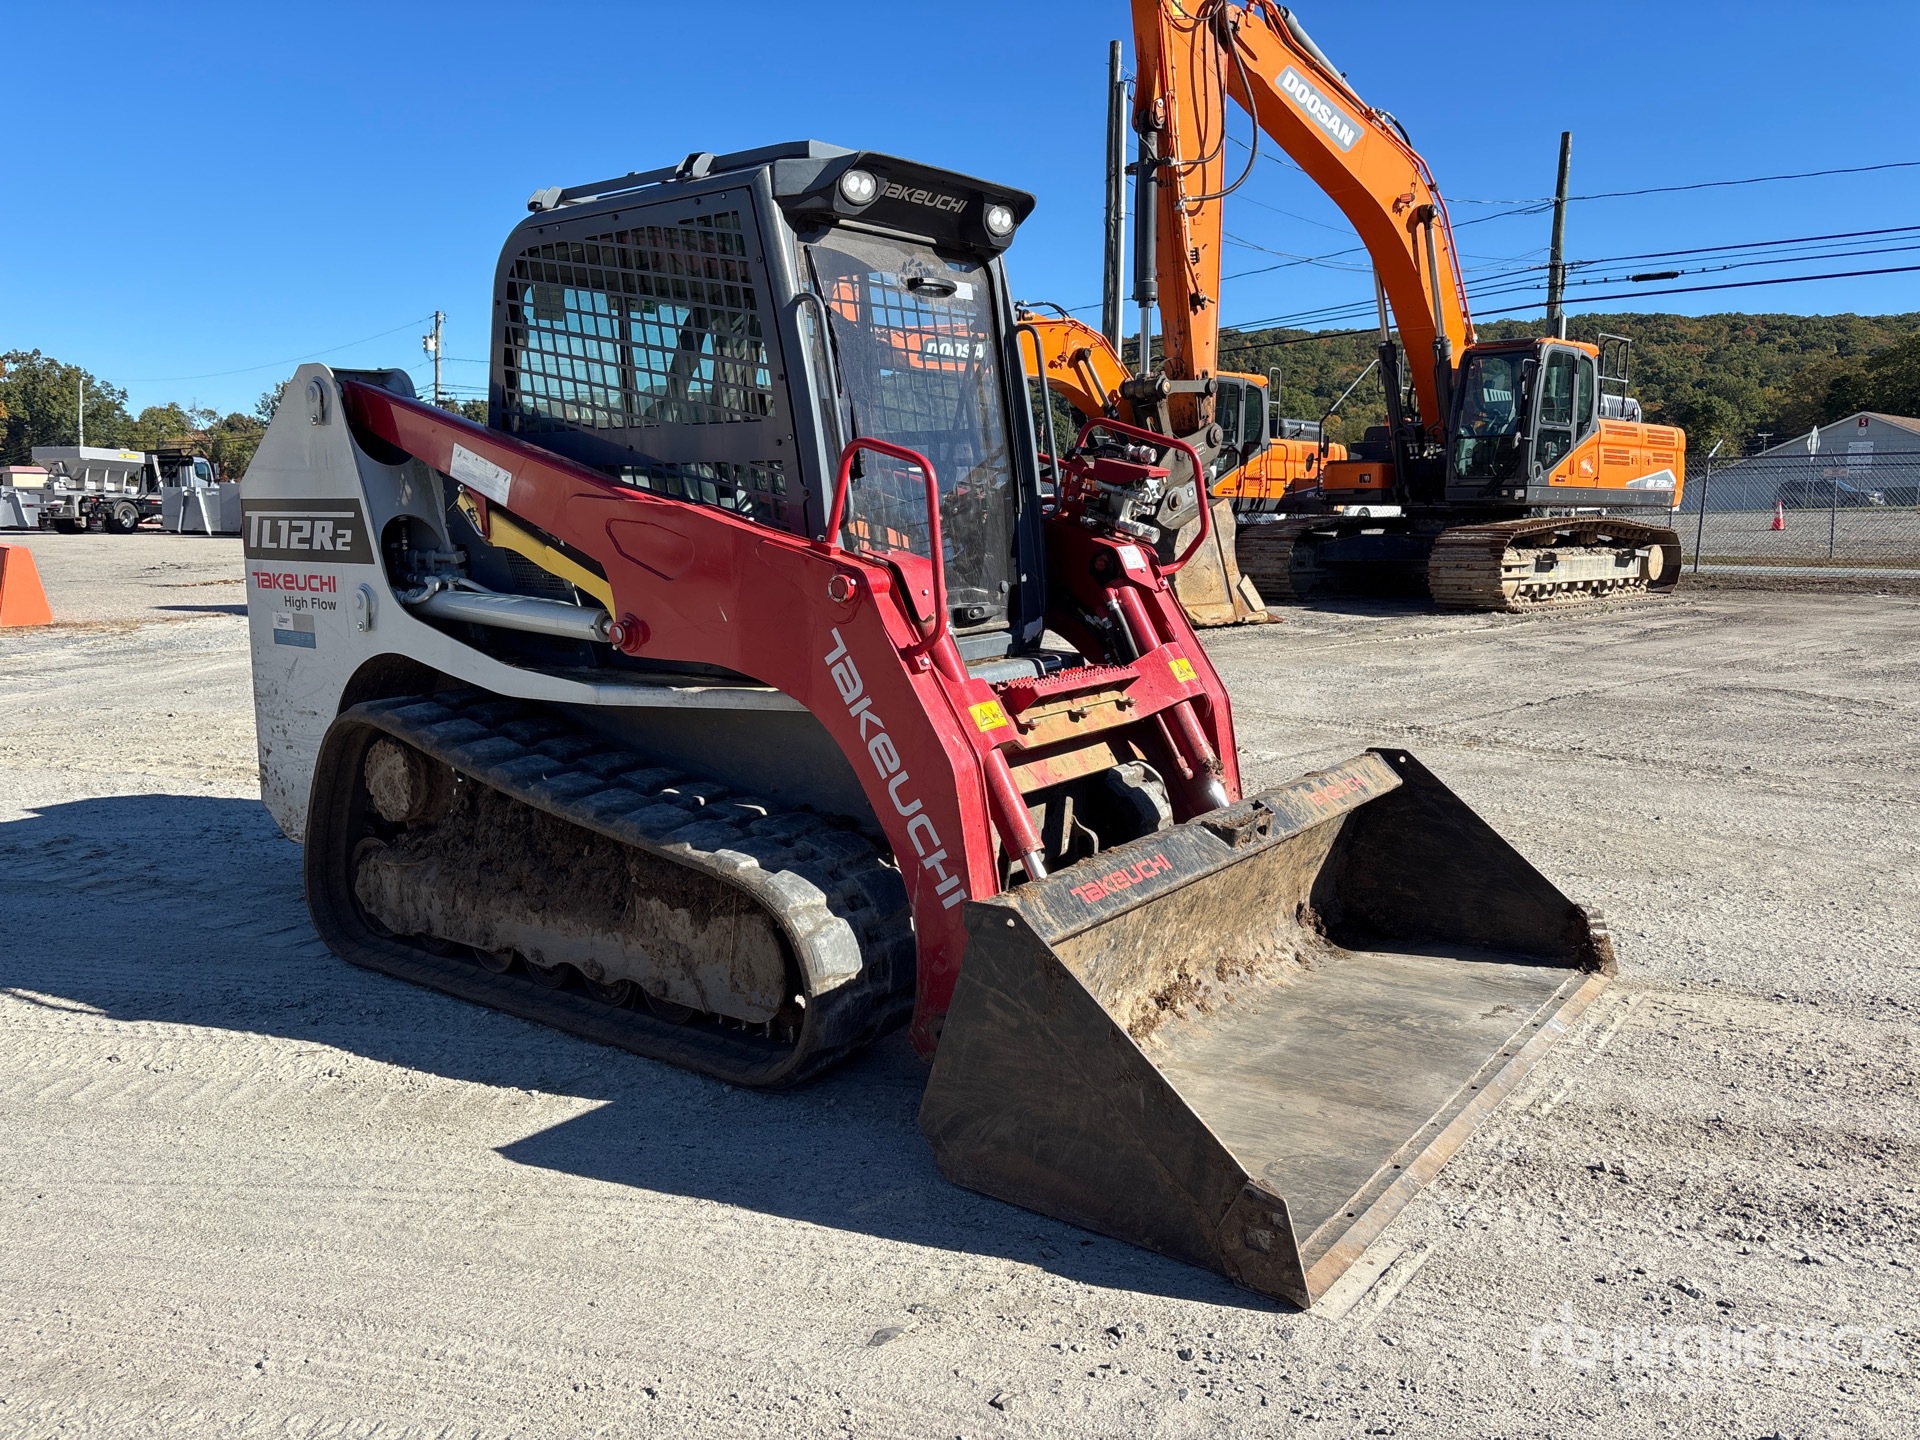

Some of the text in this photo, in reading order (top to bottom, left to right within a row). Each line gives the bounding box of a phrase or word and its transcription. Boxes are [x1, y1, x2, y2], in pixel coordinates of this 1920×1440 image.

[1282, 70, 1355, 147] DOOSAN
[881, 181, 968, 214] TAKEUCHI
[245, 510, 355, 551] TL12R2
[252, 571, 337, 593] TAKEUCHI
[284, 595, 337, 611] High Flow
[824, 627, 968, 910] TAKEUCHI
[1070, 853, 1172, 904] TAKEUCHI
